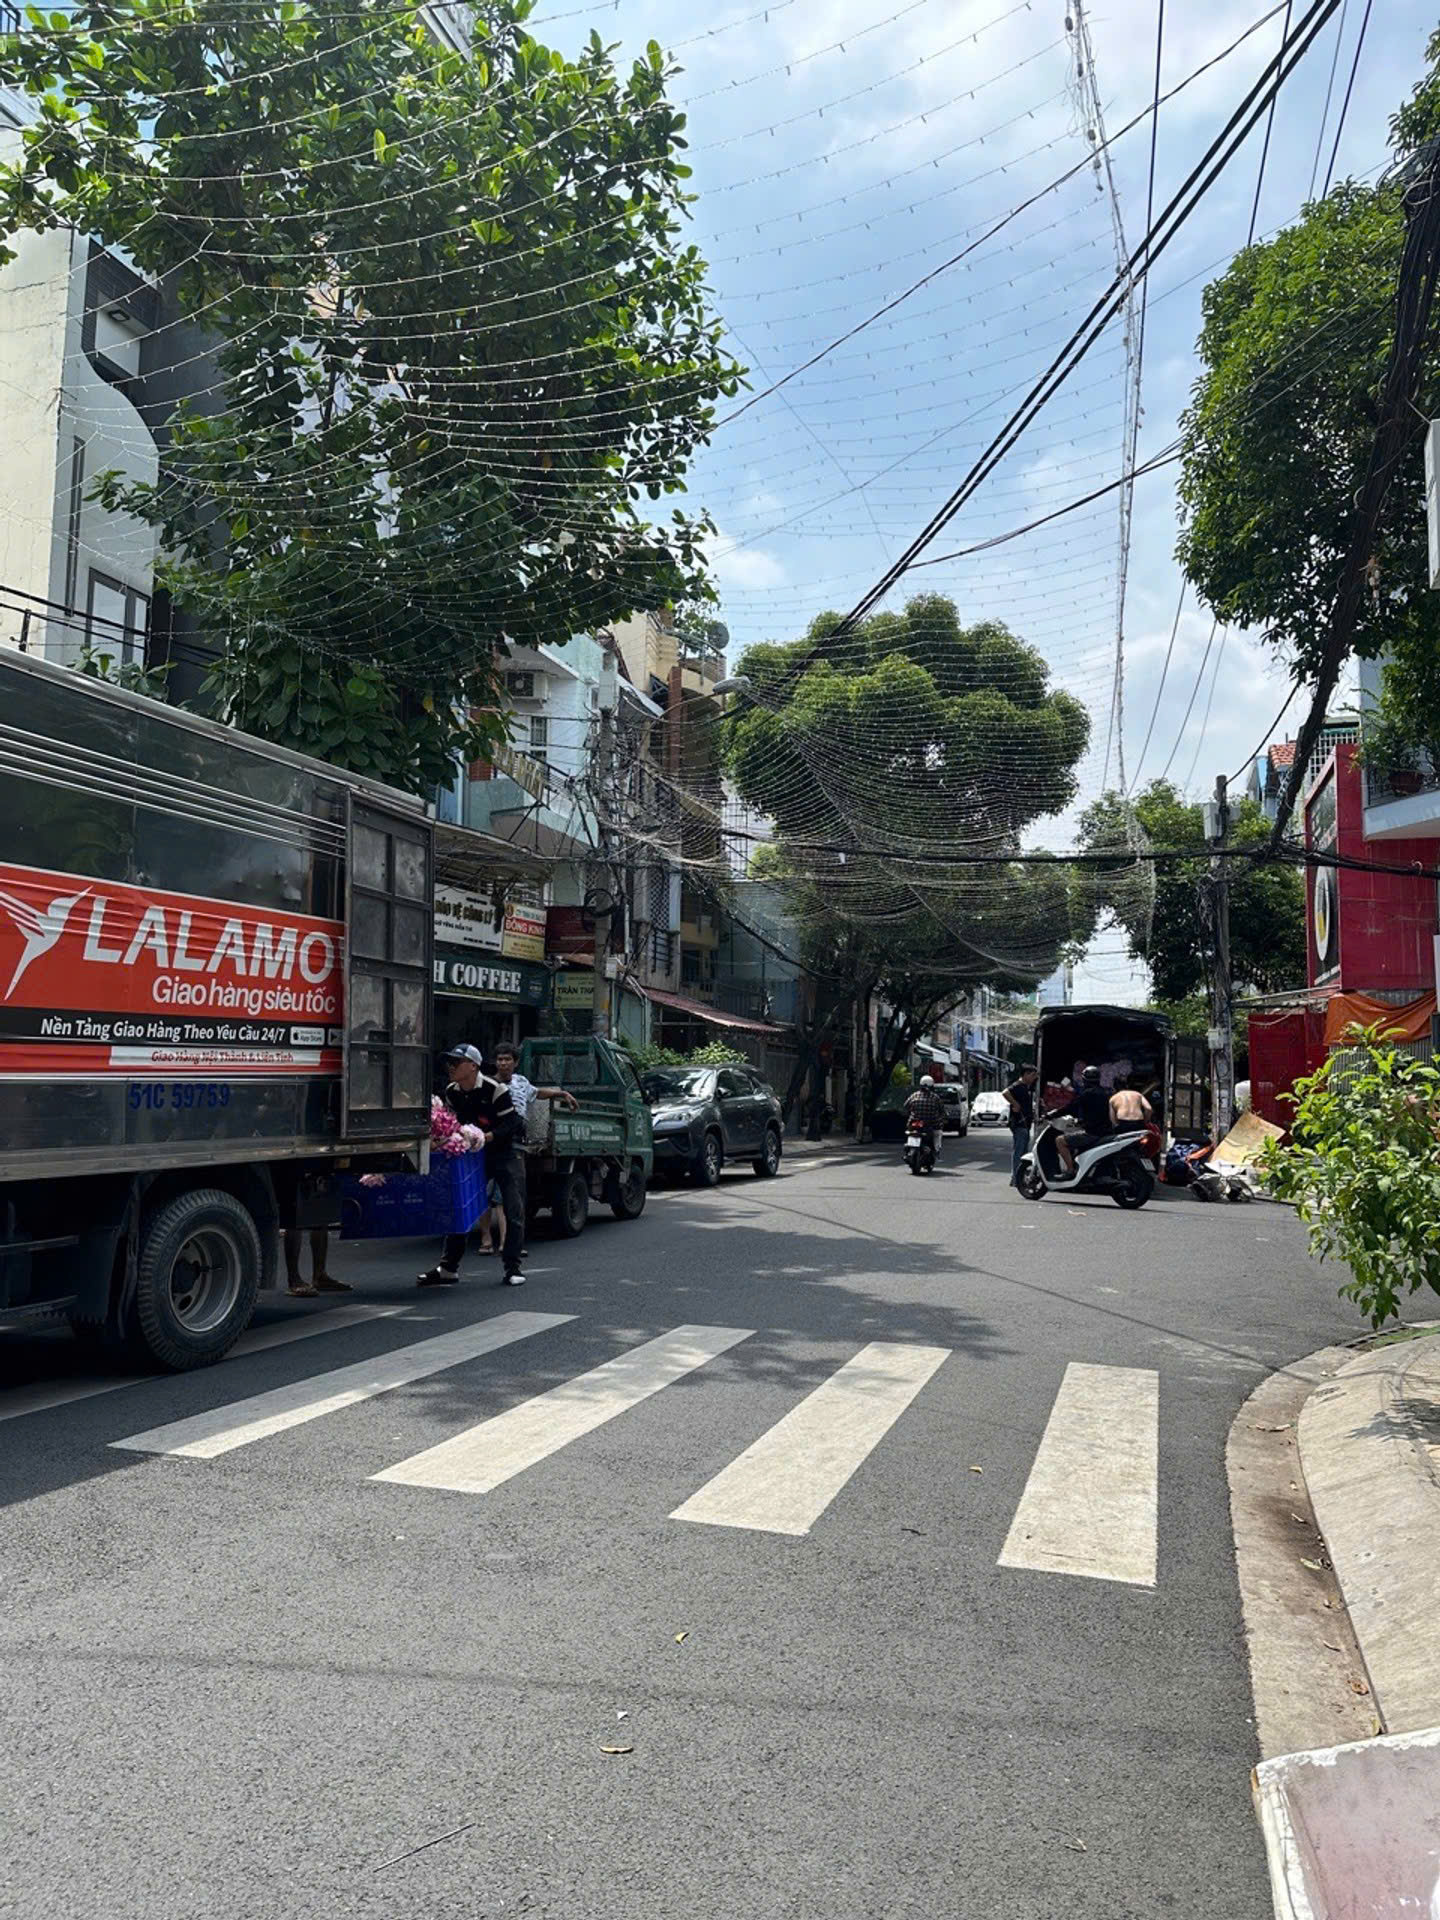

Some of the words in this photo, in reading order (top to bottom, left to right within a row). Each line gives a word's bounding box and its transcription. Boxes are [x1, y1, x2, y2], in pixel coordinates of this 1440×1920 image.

[83, 896, 344, 984] LALAMO
[452, 963, 521, 993] COFFEE
[152, 975, 207, 1006] Giao
[209, 978, 264, 1016] hàng
[264, 985, 307, 1012] siêu
[306, 985, 336, 1015] tốc
[41, 1016, 71, 1035] Nền
[75, 1017, 111, 1041] Tảng
[113, 1020, 144, 1038] Giao
[146, 1020, 182, 1043] Hàng
[183, 1023, 214, 1040] Theo
[216, 1024, 237, 1040] Yêu
[238, 1024, 260, 1041] Cầu
[261, 1026, 286, 1044] 24/7
[151, 1050, 174, 1062] Giao
[129, 1083, 165, 1110] 51C
[171, 1083, 230, 1108] 59759
